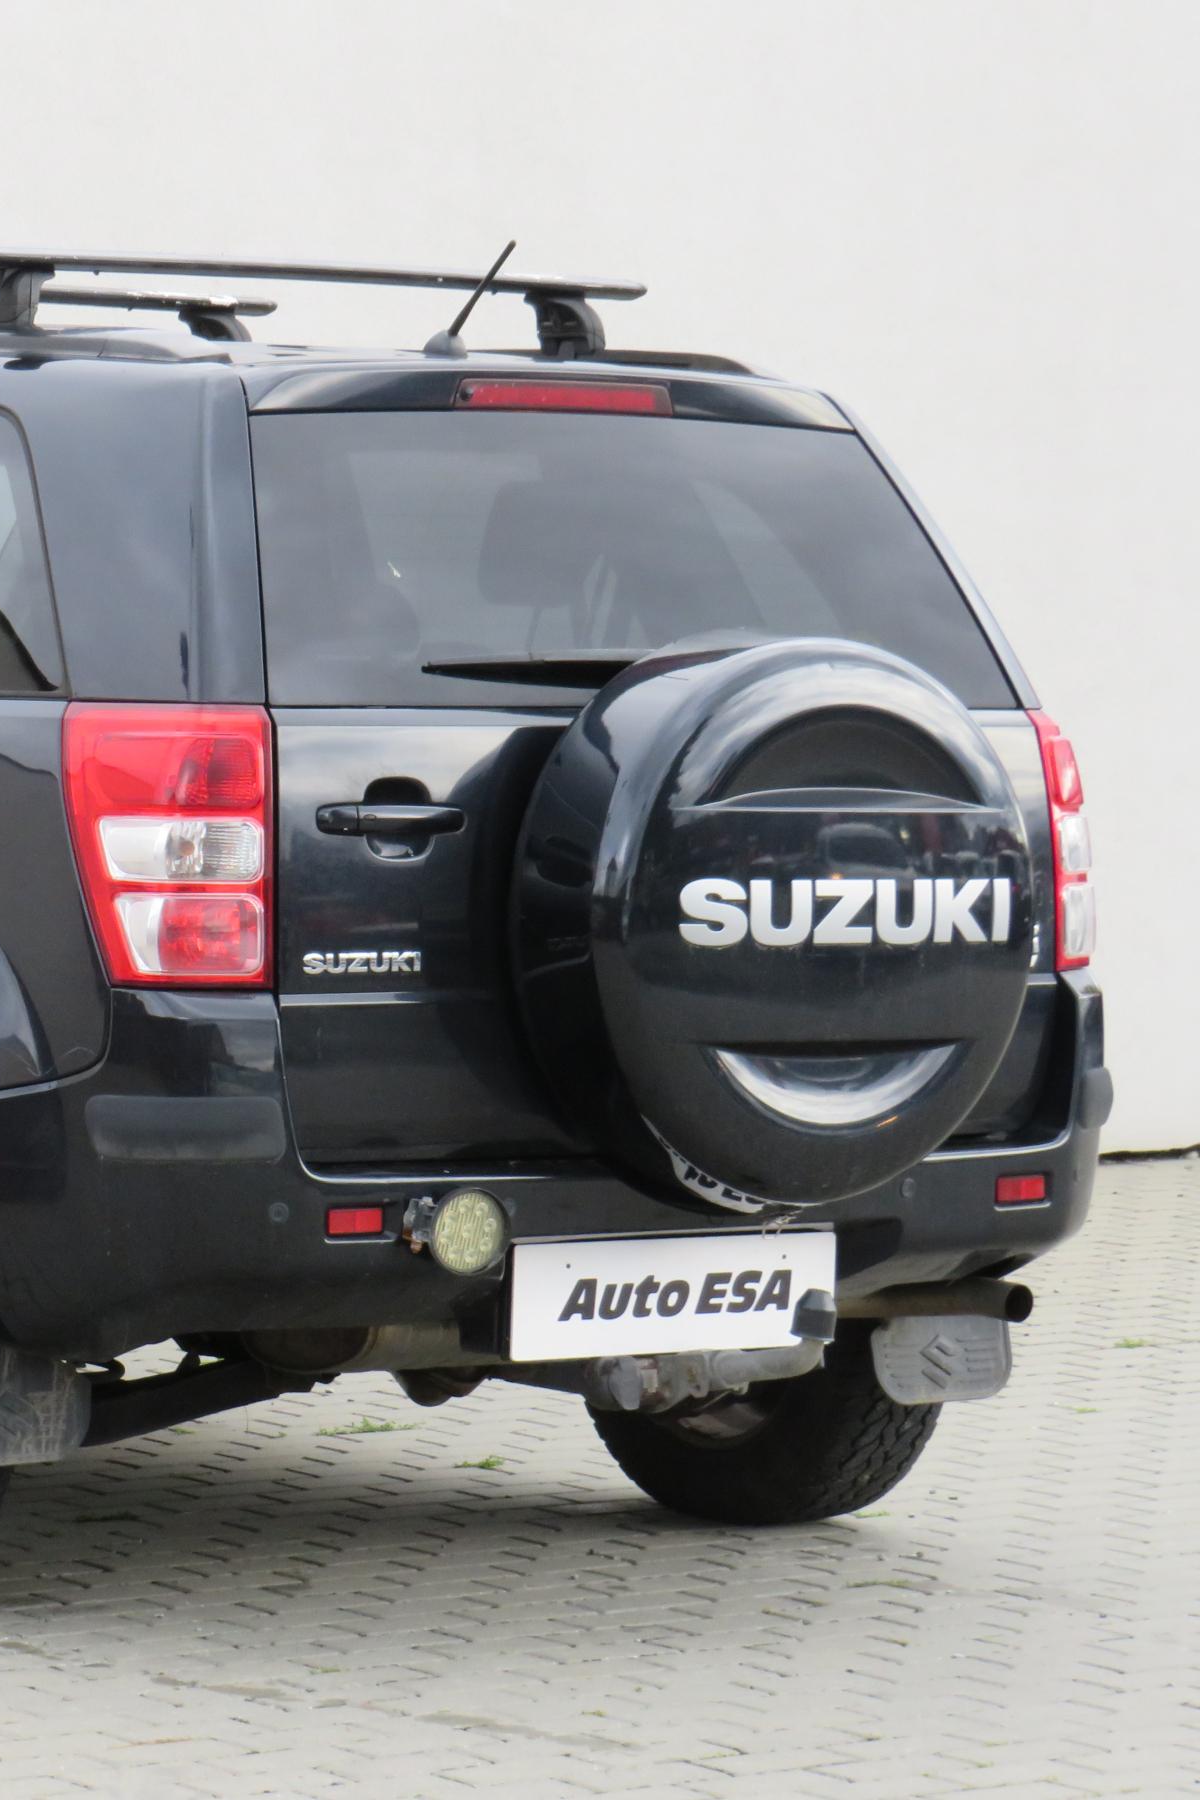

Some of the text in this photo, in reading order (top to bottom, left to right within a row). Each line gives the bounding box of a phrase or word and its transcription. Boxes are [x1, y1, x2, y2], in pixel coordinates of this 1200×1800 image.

[679, 878, 1011, 946] SUZUKI
[302, 951, 421, 975] SUZUKI
[558, 1269, 792, 1321] Auto ESA
